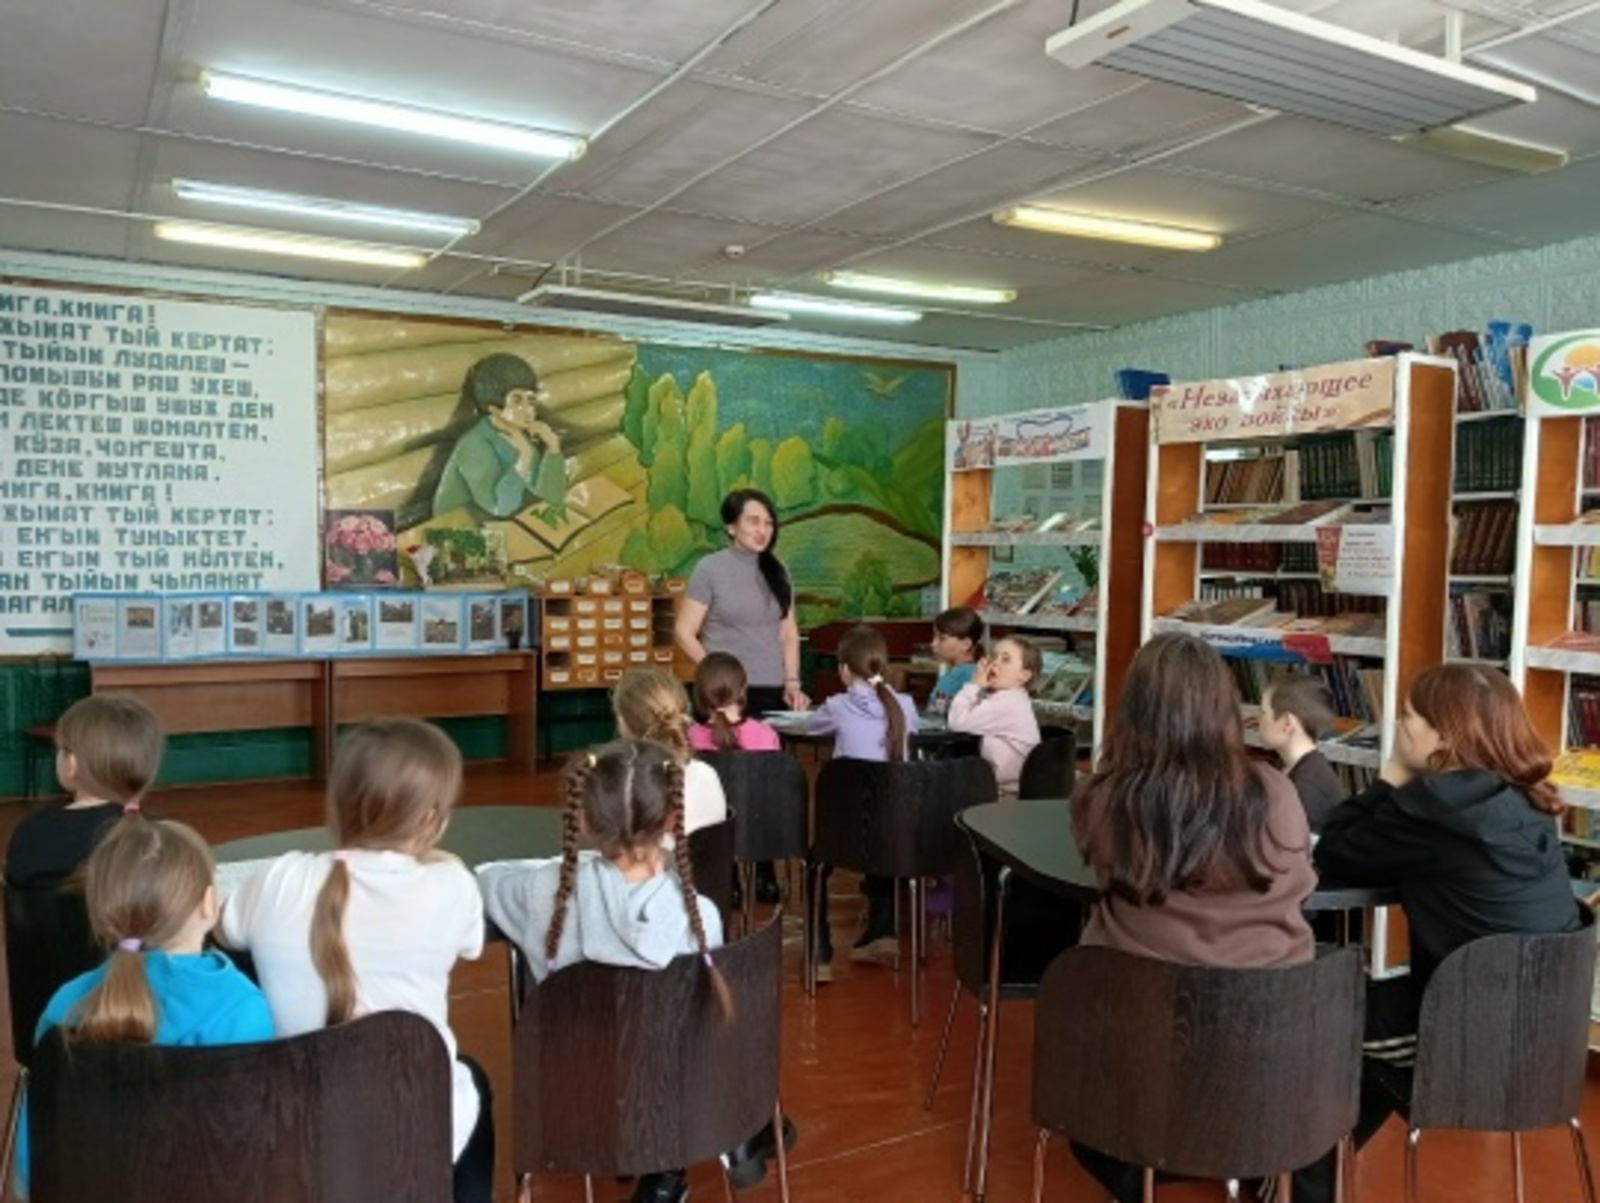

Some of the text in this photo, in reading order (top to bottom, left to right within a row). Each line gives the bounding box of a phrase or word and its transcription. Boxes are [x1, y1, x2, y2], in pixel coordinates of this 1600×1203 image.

[105, 325, 160, 347] ТЫЙ
[171, 331, 273, 355] КЕРТАТ:
[114, 350, 226, 373] ЛУДАЛЕШ
[133, 373, 179, 392] РАШ
[228, 401, 274, 419] ДЕН
[20, 412, 122, 434] ЛЕКТЕШ
[15, 458, 83, 478] ДЕНЕ
[106, 502, 159, 524] ТЫЙ
[171, 507, 273, 526] КЕРТАТ:
[115, 548, 169, 569] ТЫЙ
[150, 572, 263, 591] ЧЫЛАНАТ
